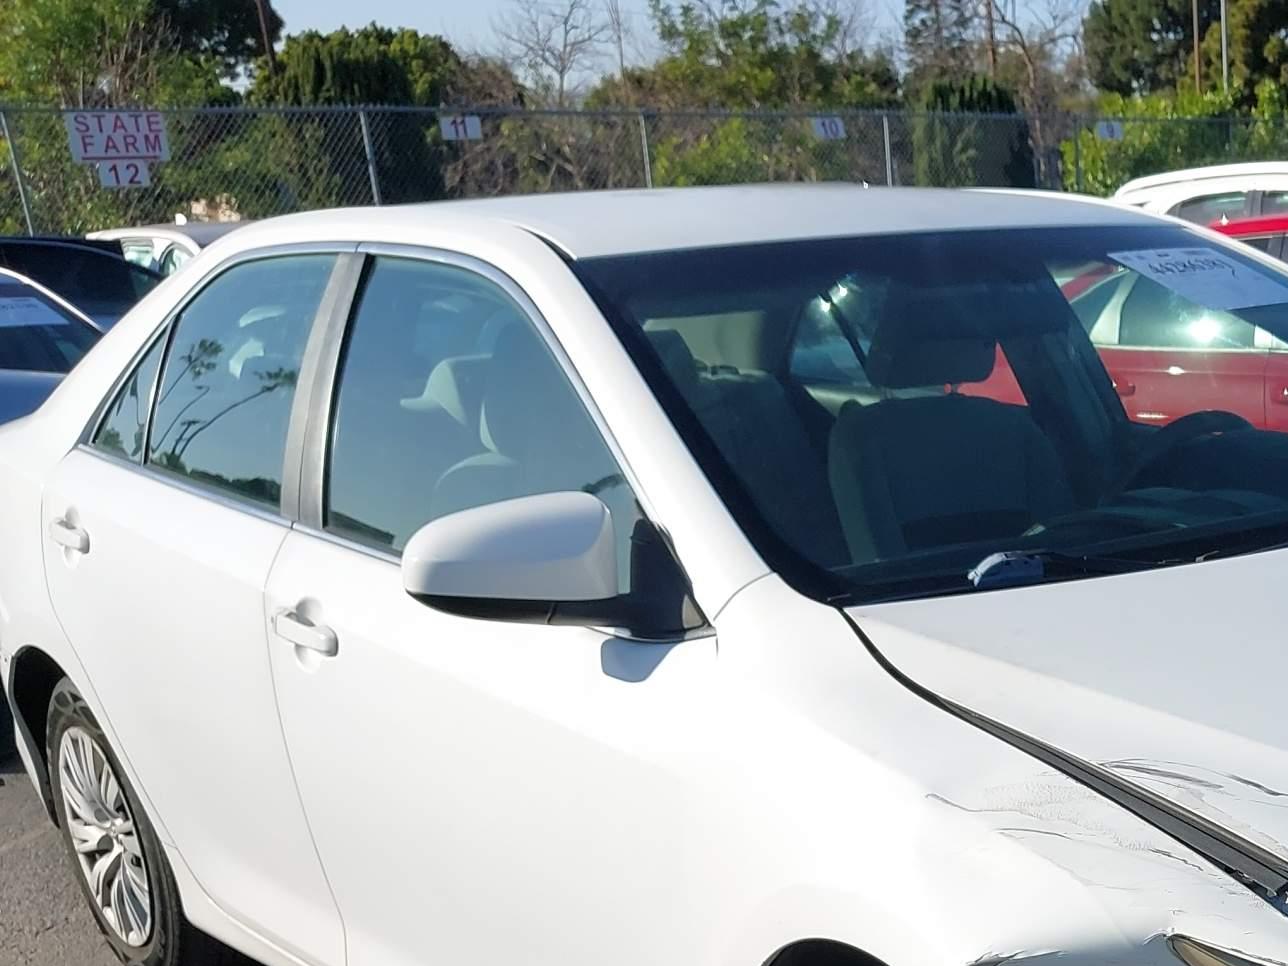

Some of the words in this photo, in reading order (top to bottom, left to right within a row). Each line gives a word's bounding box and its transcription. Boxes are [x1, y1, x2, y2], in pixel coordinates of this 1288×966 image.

[73, 114, 163, 133] STATE
[450, 118, 469, 138] 11
[821, 119, 840, 138] 10
[80, 134, 162, 154] FARM
[108, 163, 142, 185] 12
